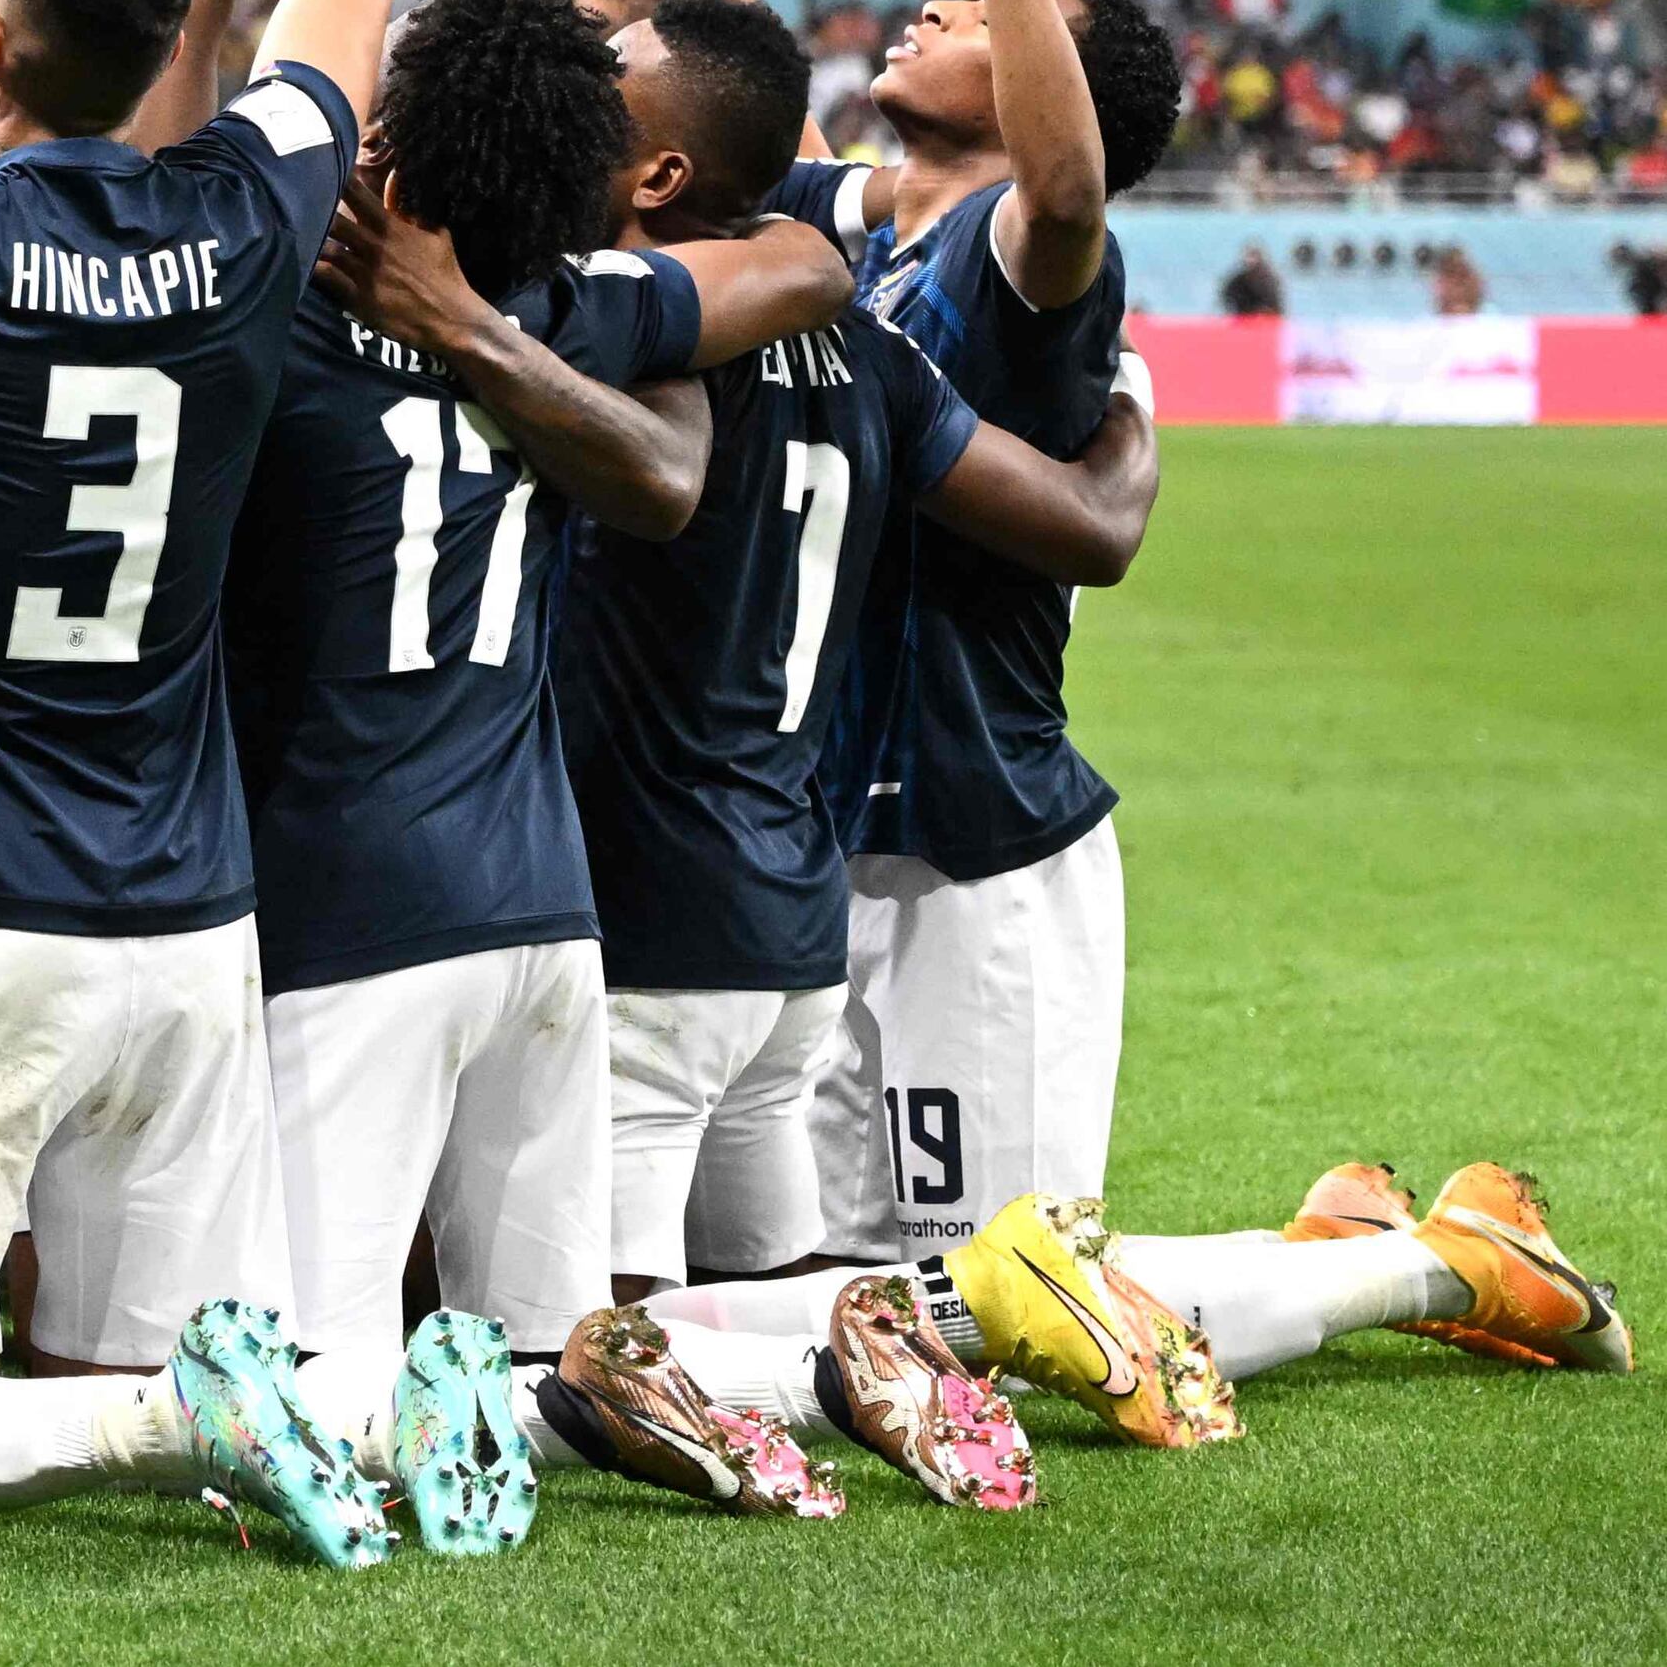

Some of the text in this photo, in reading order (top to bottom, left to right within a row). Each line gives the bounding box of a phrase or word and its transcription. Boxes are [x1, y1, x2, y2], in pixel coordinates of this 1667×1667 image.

[10, 239, 222, 317] HINCAPIE
[5, 364, 183, 663] 3
[380, 396, 538, 673] 17
[777, 439, 851, 733] 7
[885, 1087, 964, 1204] 19
